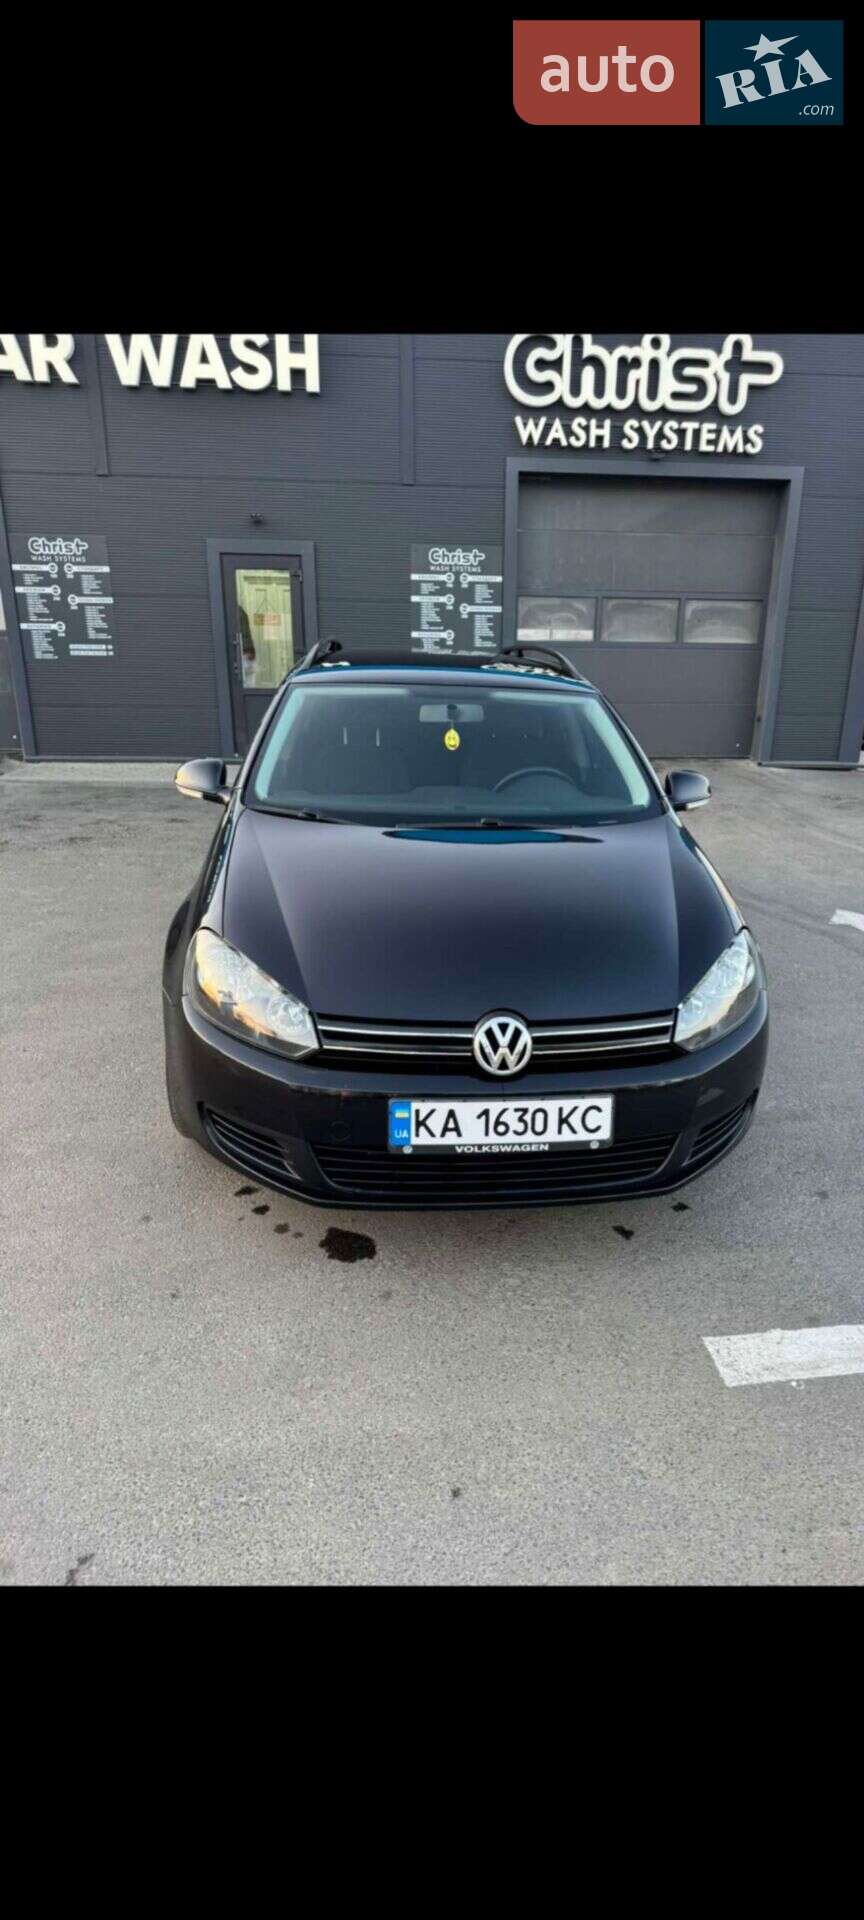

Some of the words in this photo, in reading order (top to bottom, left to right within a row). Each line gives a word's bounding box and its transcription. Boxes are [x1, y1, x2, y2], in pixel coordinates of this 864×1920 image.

[104, 334, 320, 393] WASH
[504, 334, 784, 416] Christ
[514, 416, 611, 449] WASH
[621, 418, 764, 454] SYSTEMS
[28, 537, 88, 554] Christ
[429, 548, 485, 565] Christ
[414, 1108, 463, 1138] KA
[476, 1107, 548, 1137] 1630
[557, 1105, 603, 1135] KC
[395, 1130, 409, 1139] UA
[455, 1144, 549, 1153] VOLKSWAGEN
